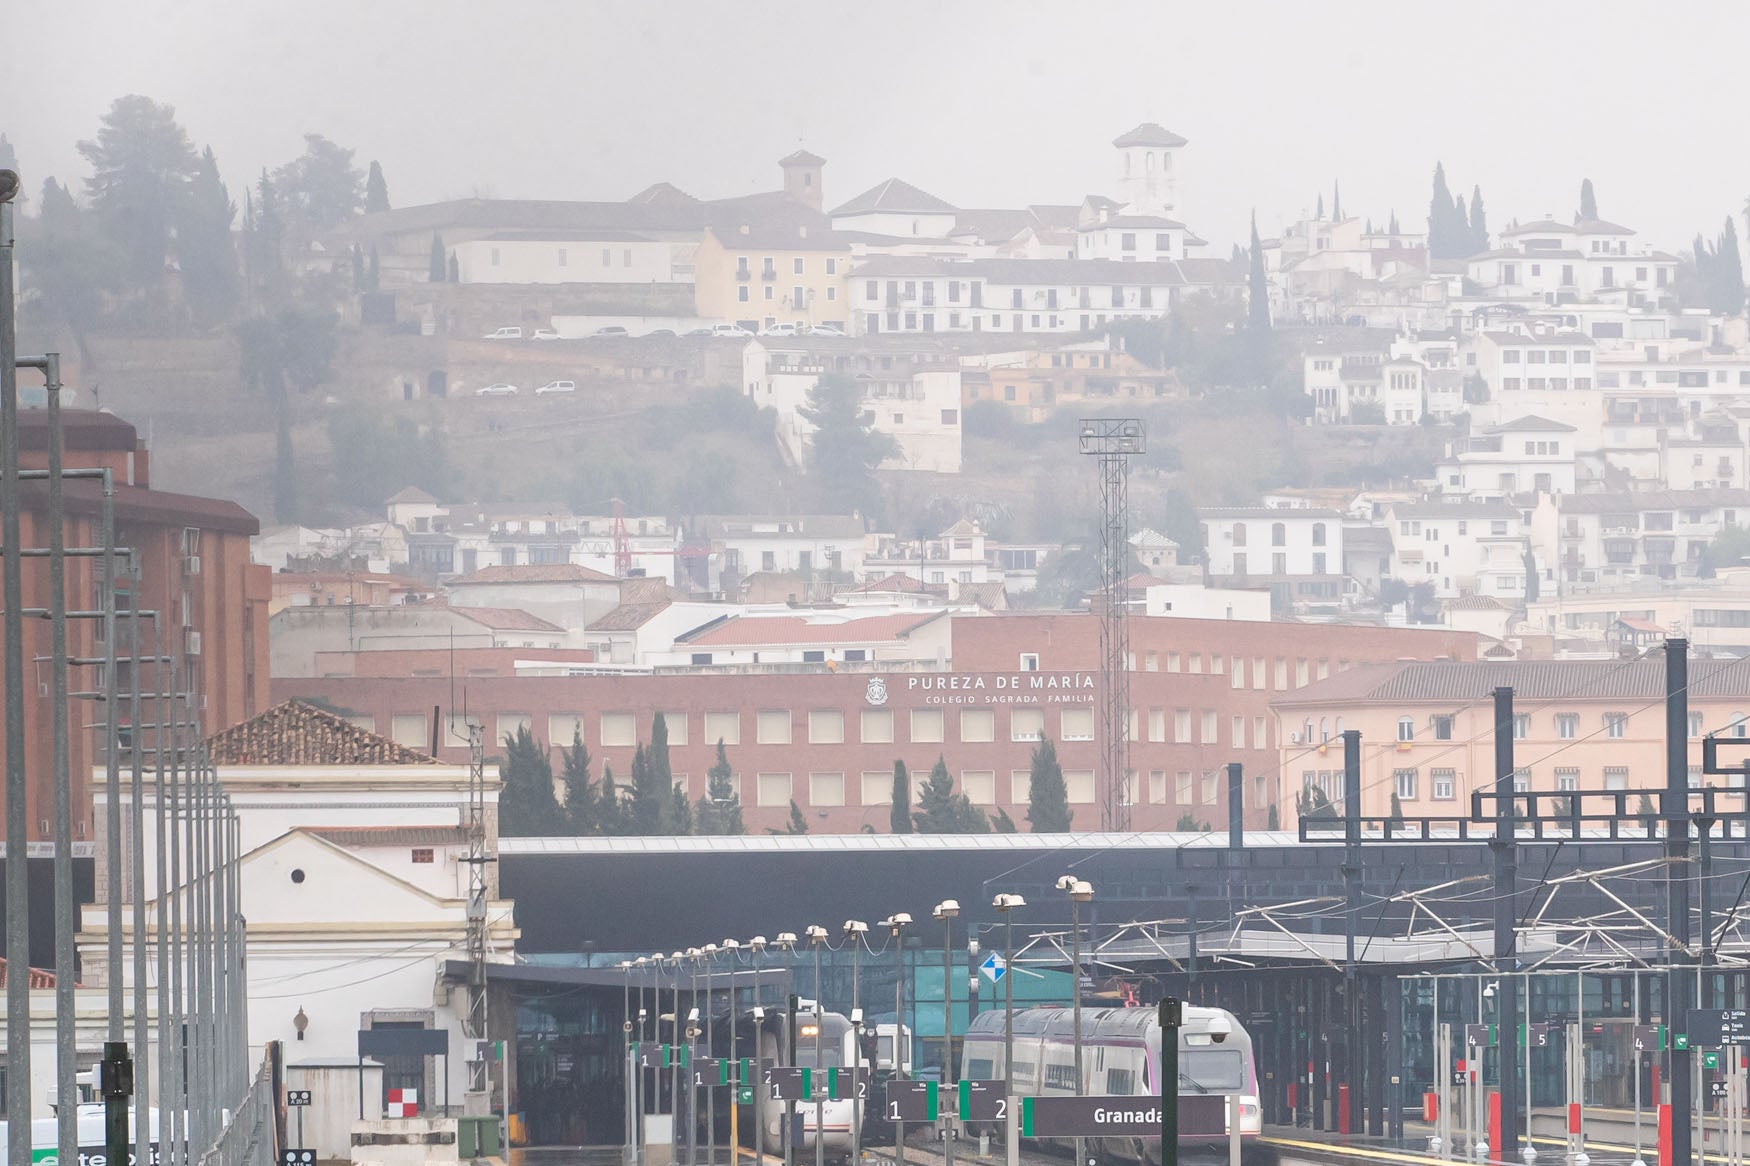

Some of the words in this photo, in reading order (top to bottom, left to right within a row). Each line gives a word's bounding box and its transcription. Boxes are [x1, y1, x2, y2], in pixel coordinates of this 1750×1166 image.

[909, 676, 985, 690] PUREZA
[997, 676, 1019, 689] DE
[1030, 672, 1094, 689] MARÍA
[926, 695, 975, 704] COLEGIO
[985, 695, 1038, 703] SAGRADA
[1048, 694, 1094, 703] FAMILIA
[1468, 1035, 1477, 1046] 4
[1538, 1035, 1546, 1045] 5
[1635, 1038, 1644, 1049] 4
[477, 1051, 484, 1061] 1
[641, 1054, 649, 1066] 1
[694, 1072, 703, 1085] 1
[772, 1083, 782, 1098] 1
[858, 1082, 866, 1098] 2
[890, 1100, 901, 1119] 1
[995, 1099, 1006, 1118] 2
